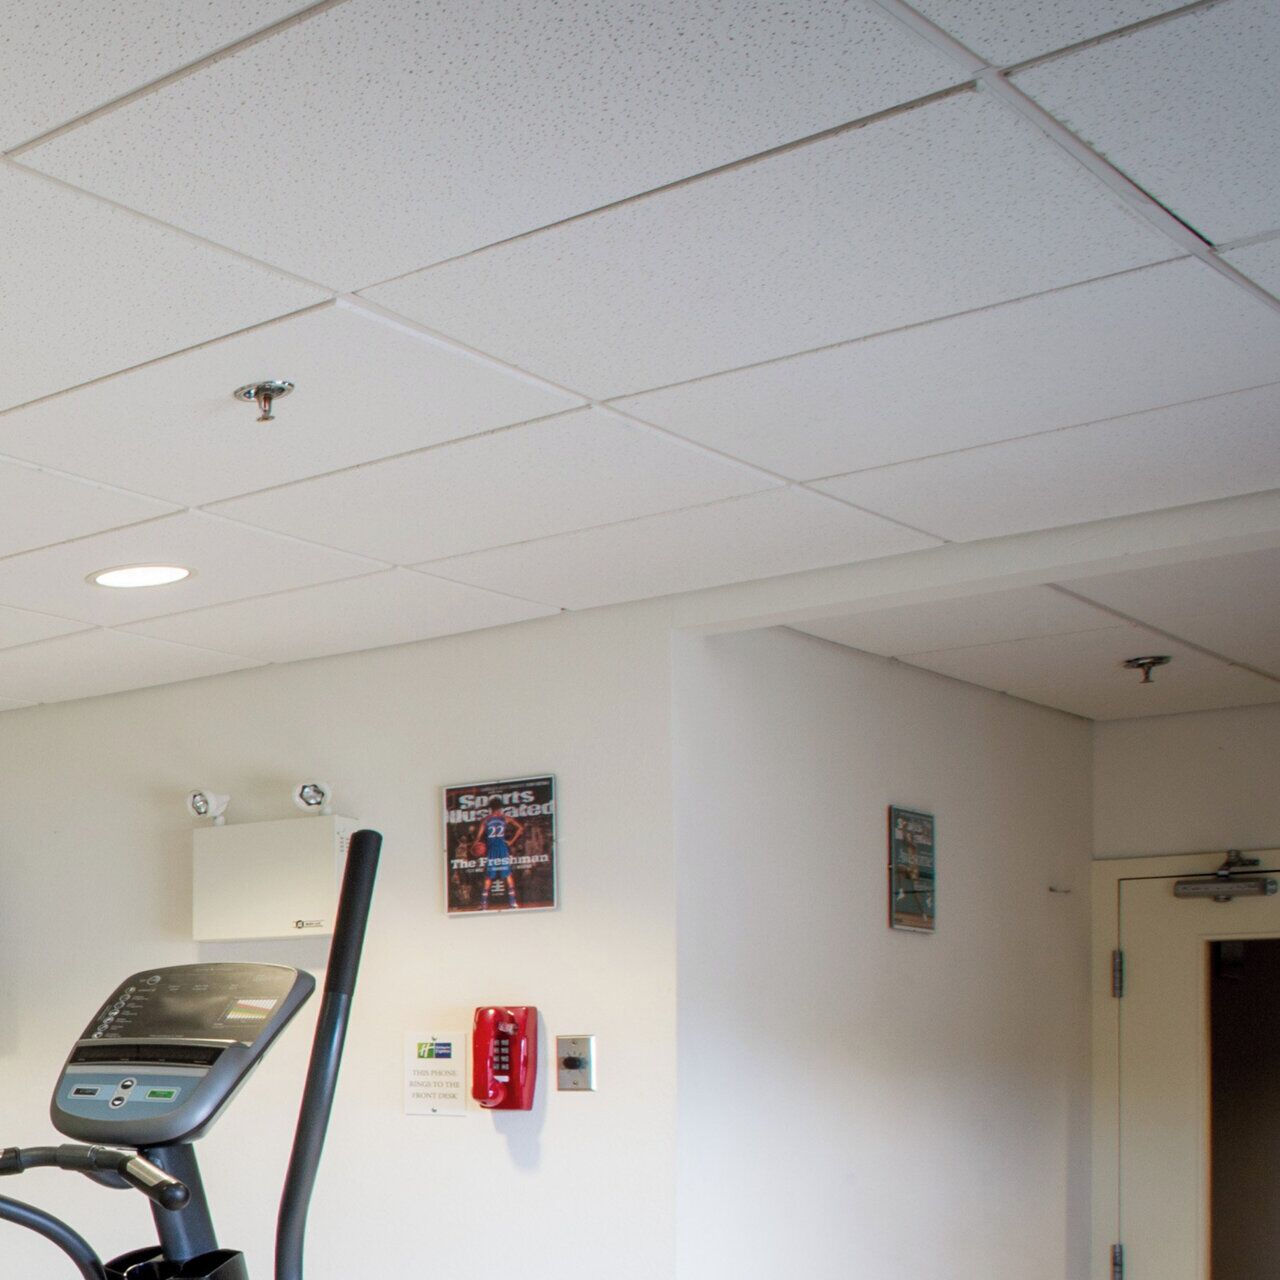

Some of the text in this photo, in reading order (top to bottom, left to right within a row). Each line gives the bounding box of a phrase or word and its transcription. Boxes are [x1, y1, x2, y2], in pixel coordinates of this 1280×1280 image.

[458, 790, 535, 810] Sports
[487, 825, 504, 838] 22
[451, 854, 549, 869] The Freshman
[431, 1069, 457, 1077] PHONE
[438, 1092, 458, 1100] DESK
